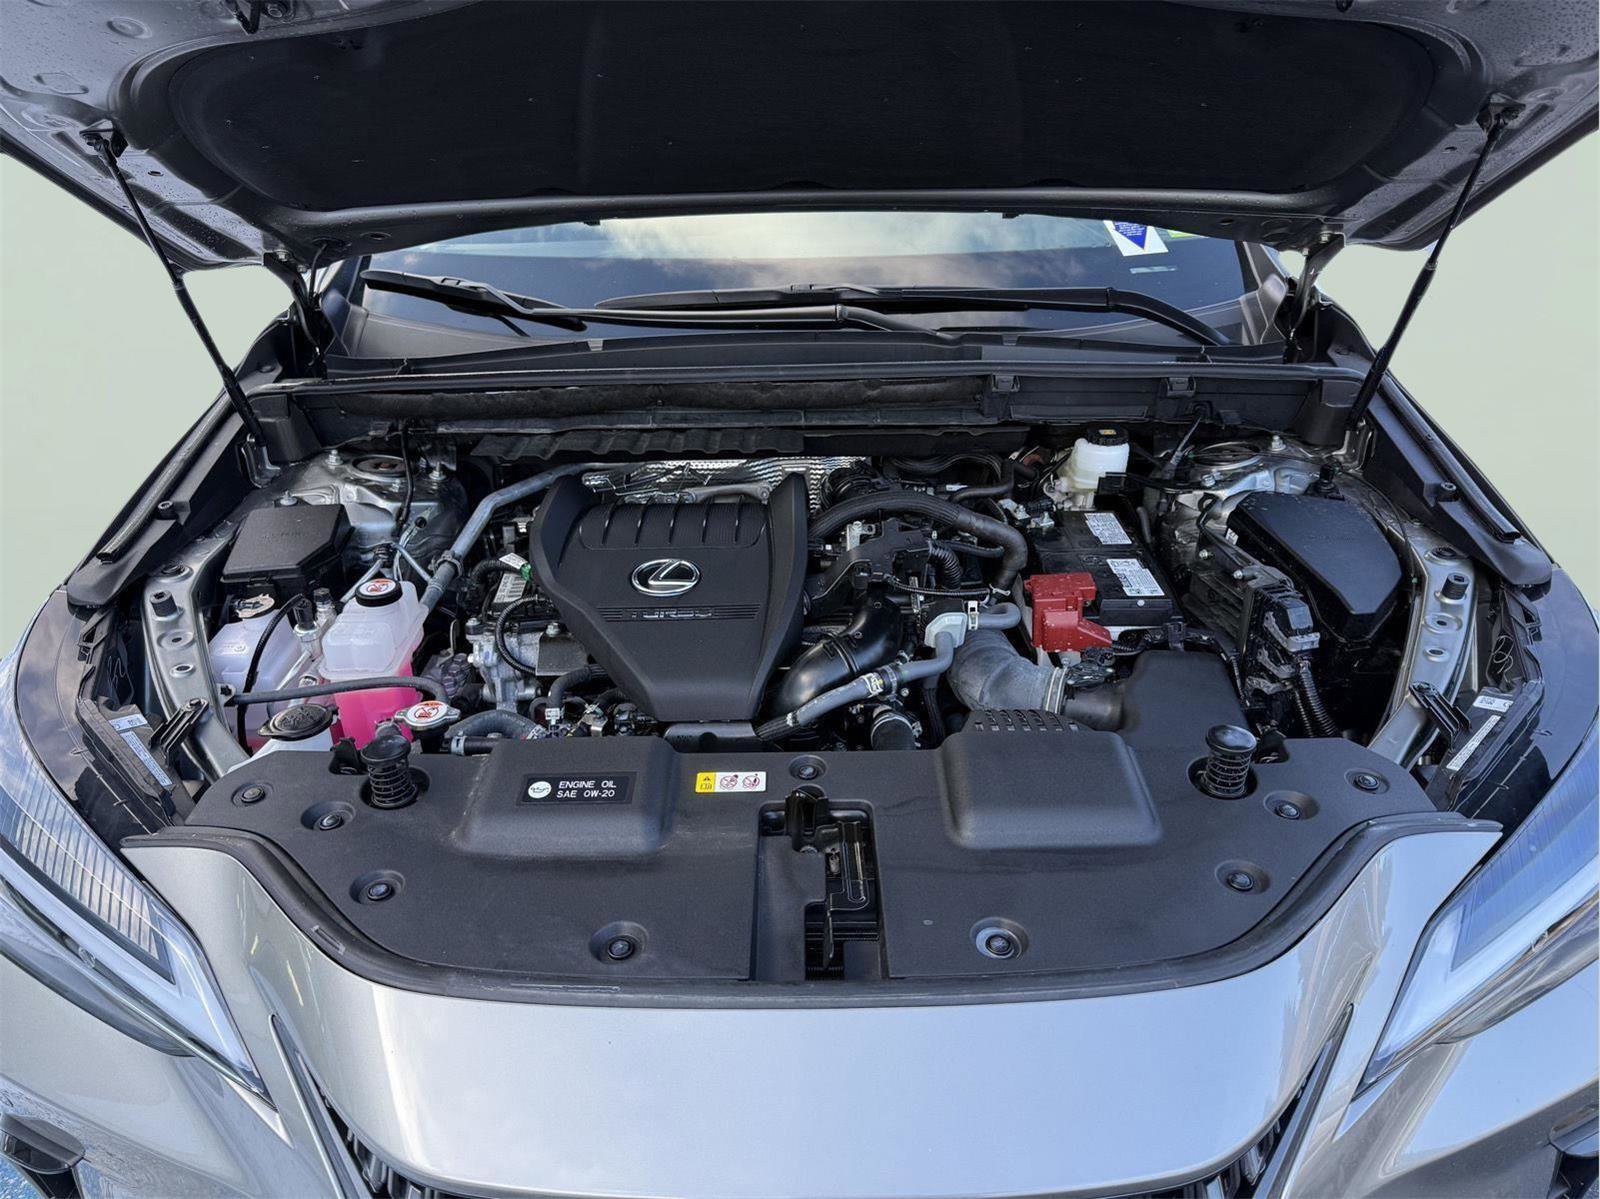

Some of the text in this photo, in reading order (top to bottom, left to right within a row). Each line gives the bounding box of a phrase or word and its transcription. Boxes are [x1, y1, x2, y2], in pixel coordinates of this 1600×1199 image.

[559, 780, 617, 789] ENGINE OIL
[556, 789, 616, 798] SAE 0W-20
